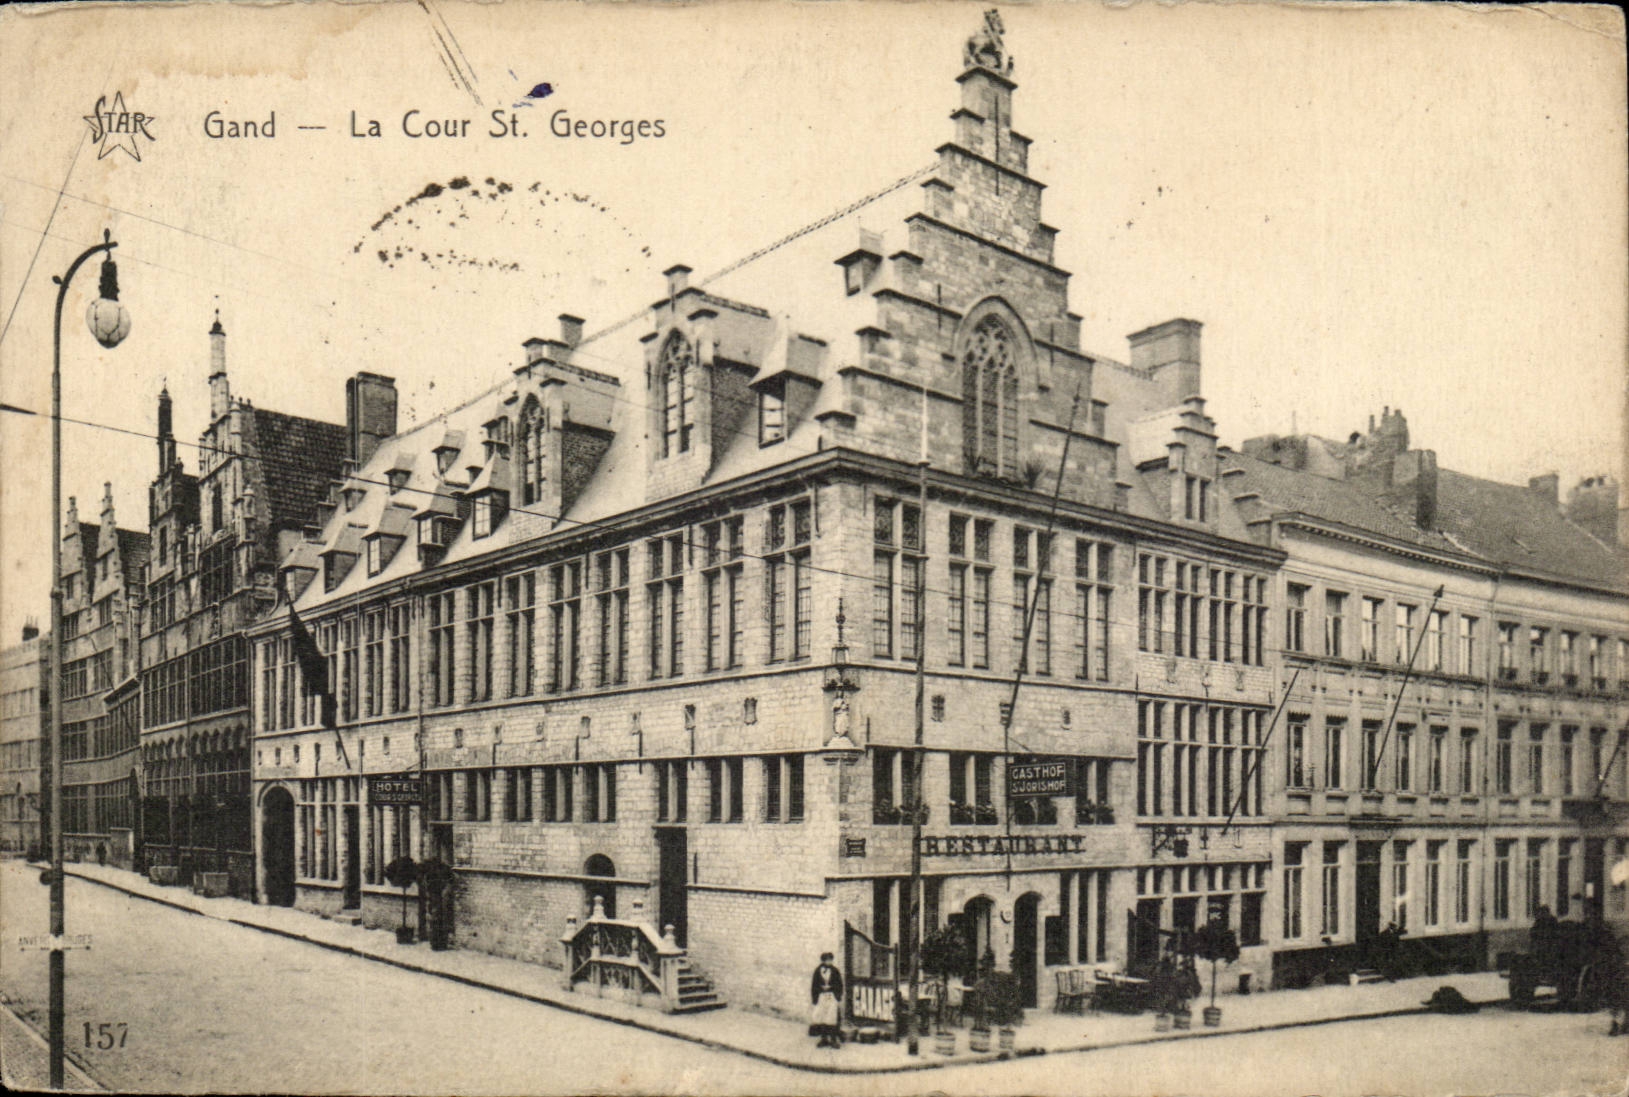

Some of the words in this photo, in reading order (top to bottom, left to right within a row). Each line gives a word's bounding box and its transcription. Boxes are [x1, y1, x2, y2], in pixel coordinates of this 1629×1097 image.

[1012, 765, 1065, 780] GASTHOF
[375, 782, 418, 793] HOTEL
[922, 835, 1086, 856] RESTAURANT
